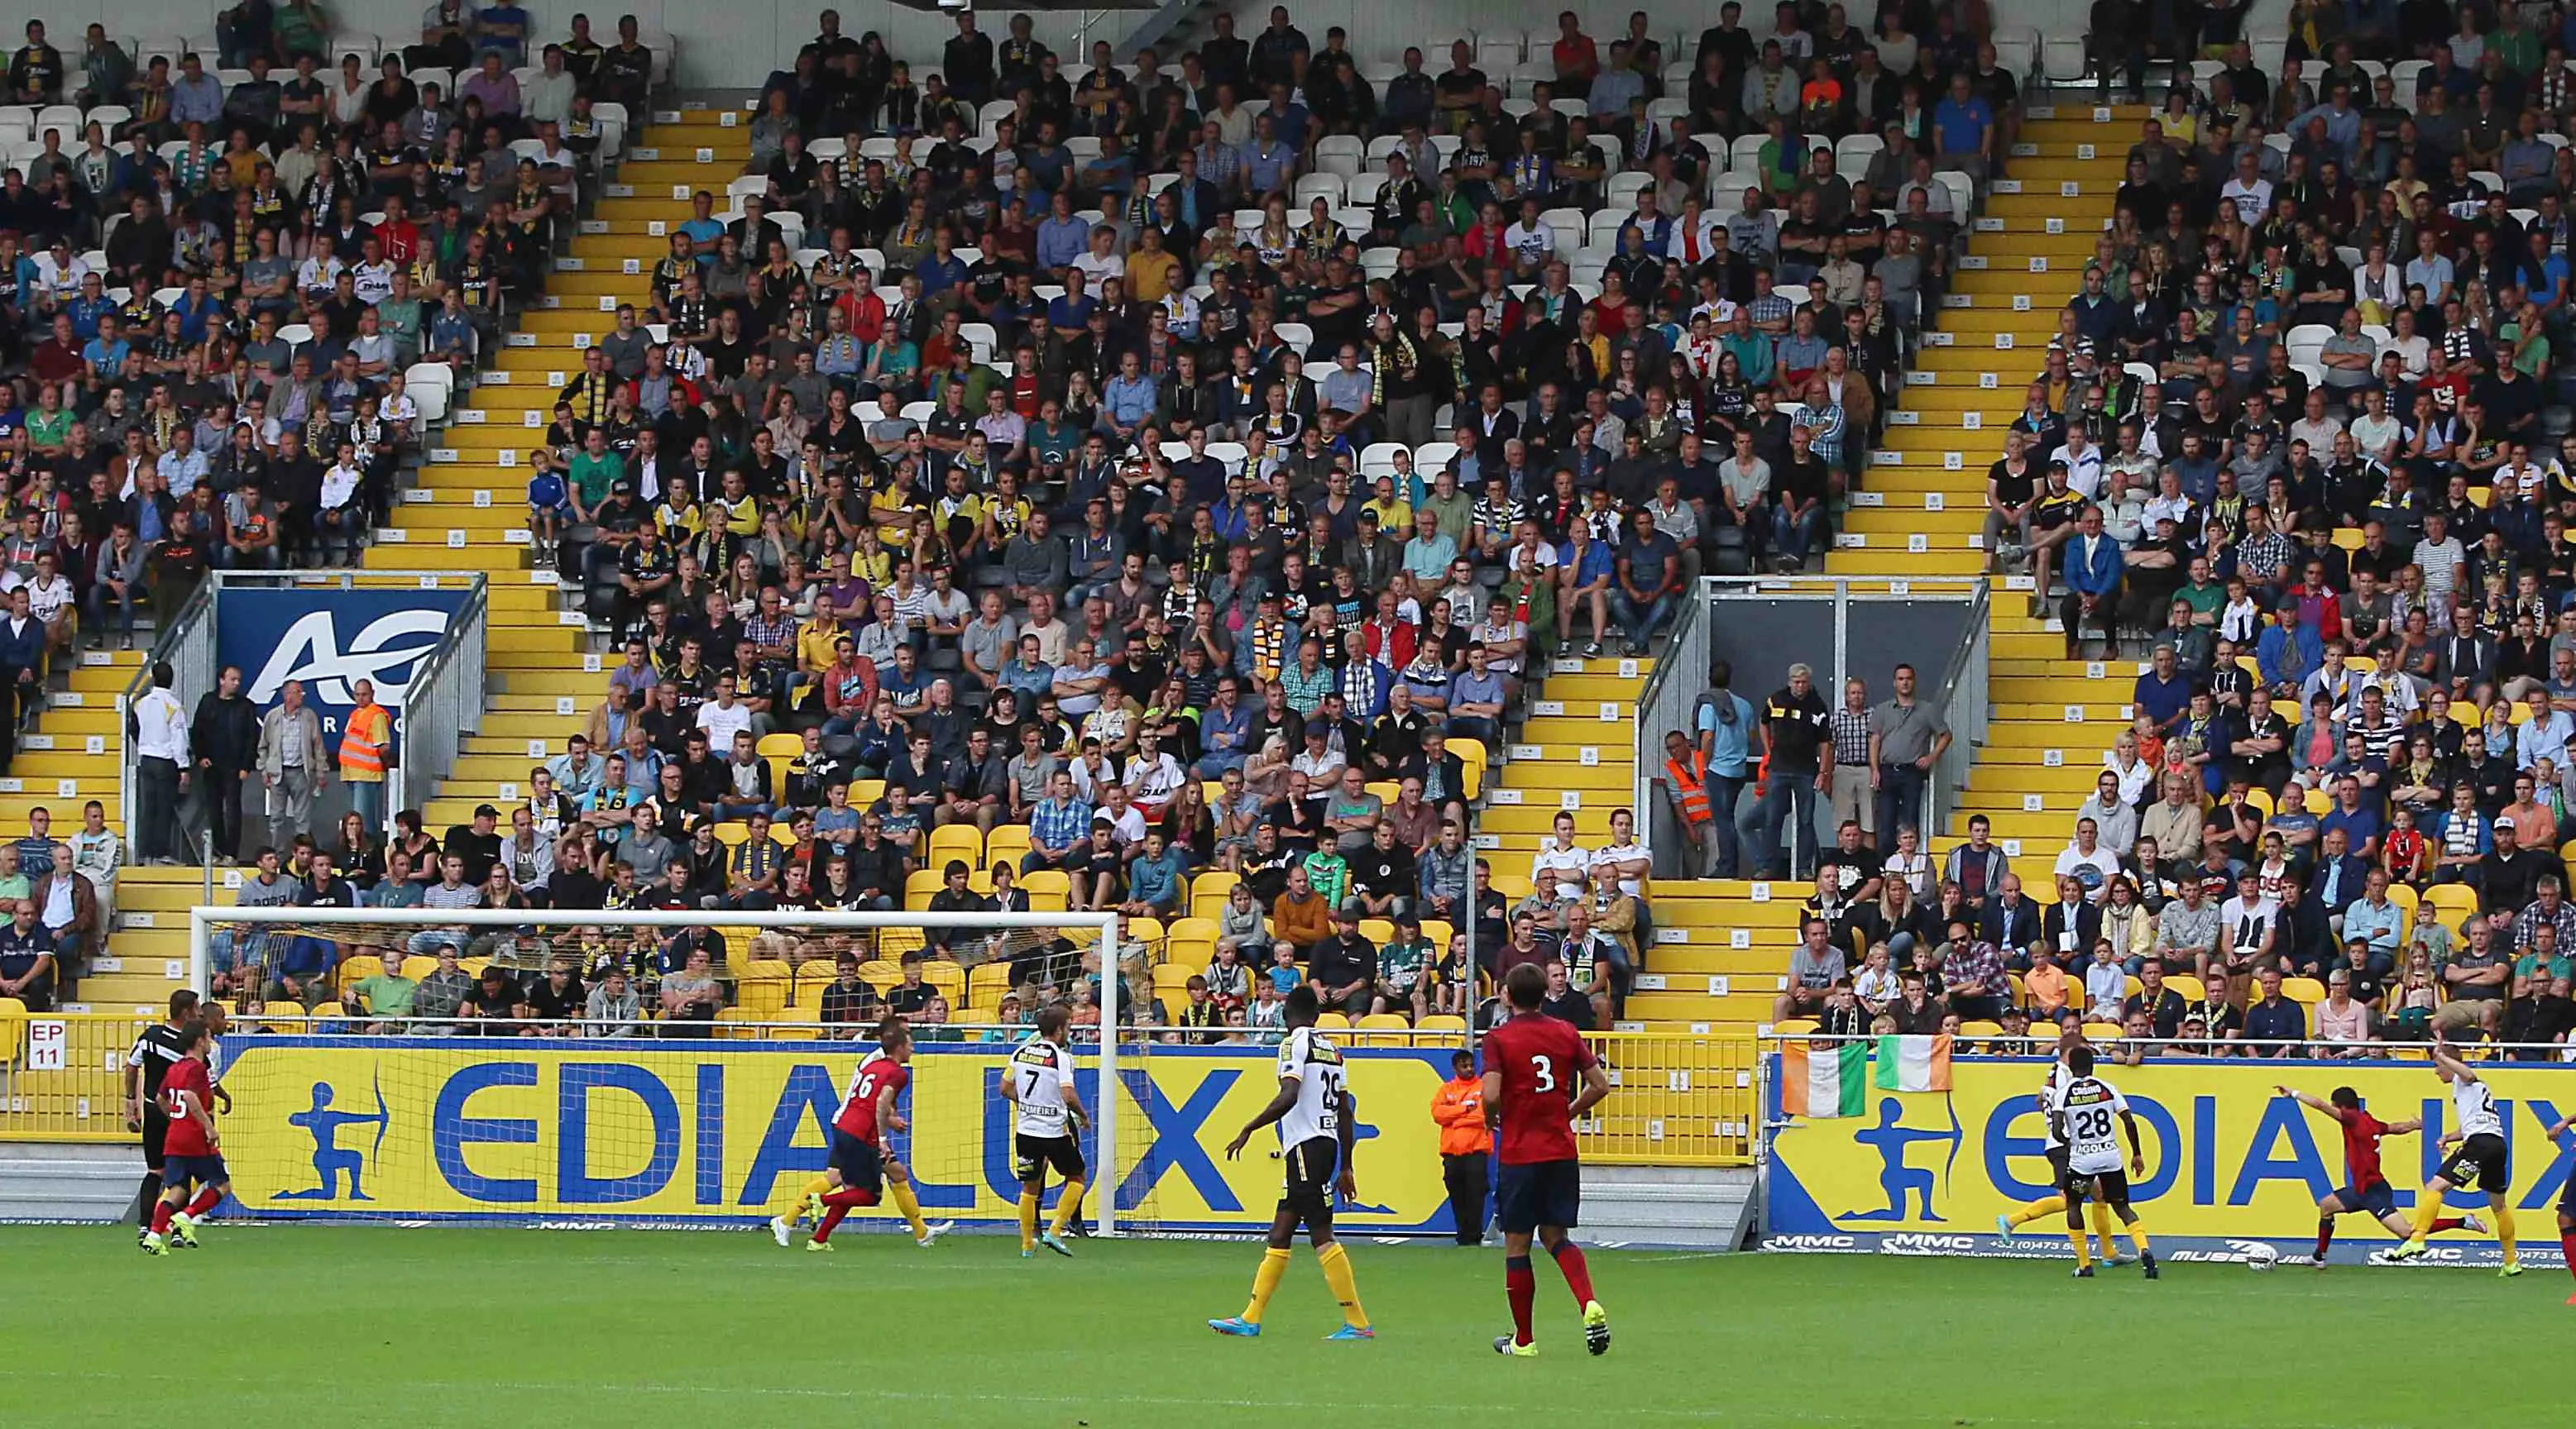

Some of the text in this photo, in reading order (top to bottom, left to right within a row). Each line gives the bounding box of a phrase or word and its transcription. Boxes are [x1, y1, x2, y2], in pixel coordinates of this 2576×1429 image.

[31, 1025, 64, 1041] EP
[36, 1048, 58, 1064] 11
[1531, 1054, 1554, 1093] 3
[1025, 1069, 1039, 1099] 7
[2076, 1107, 2112, 1140] 28
[433, 1061, 1244, 1213] EDIALUX
[1774, 1235, 1855, 1247] MMC
[1895, 1233, 1975, 1249] MMC
[2017, 1240, 2060, 1251] (0)473
